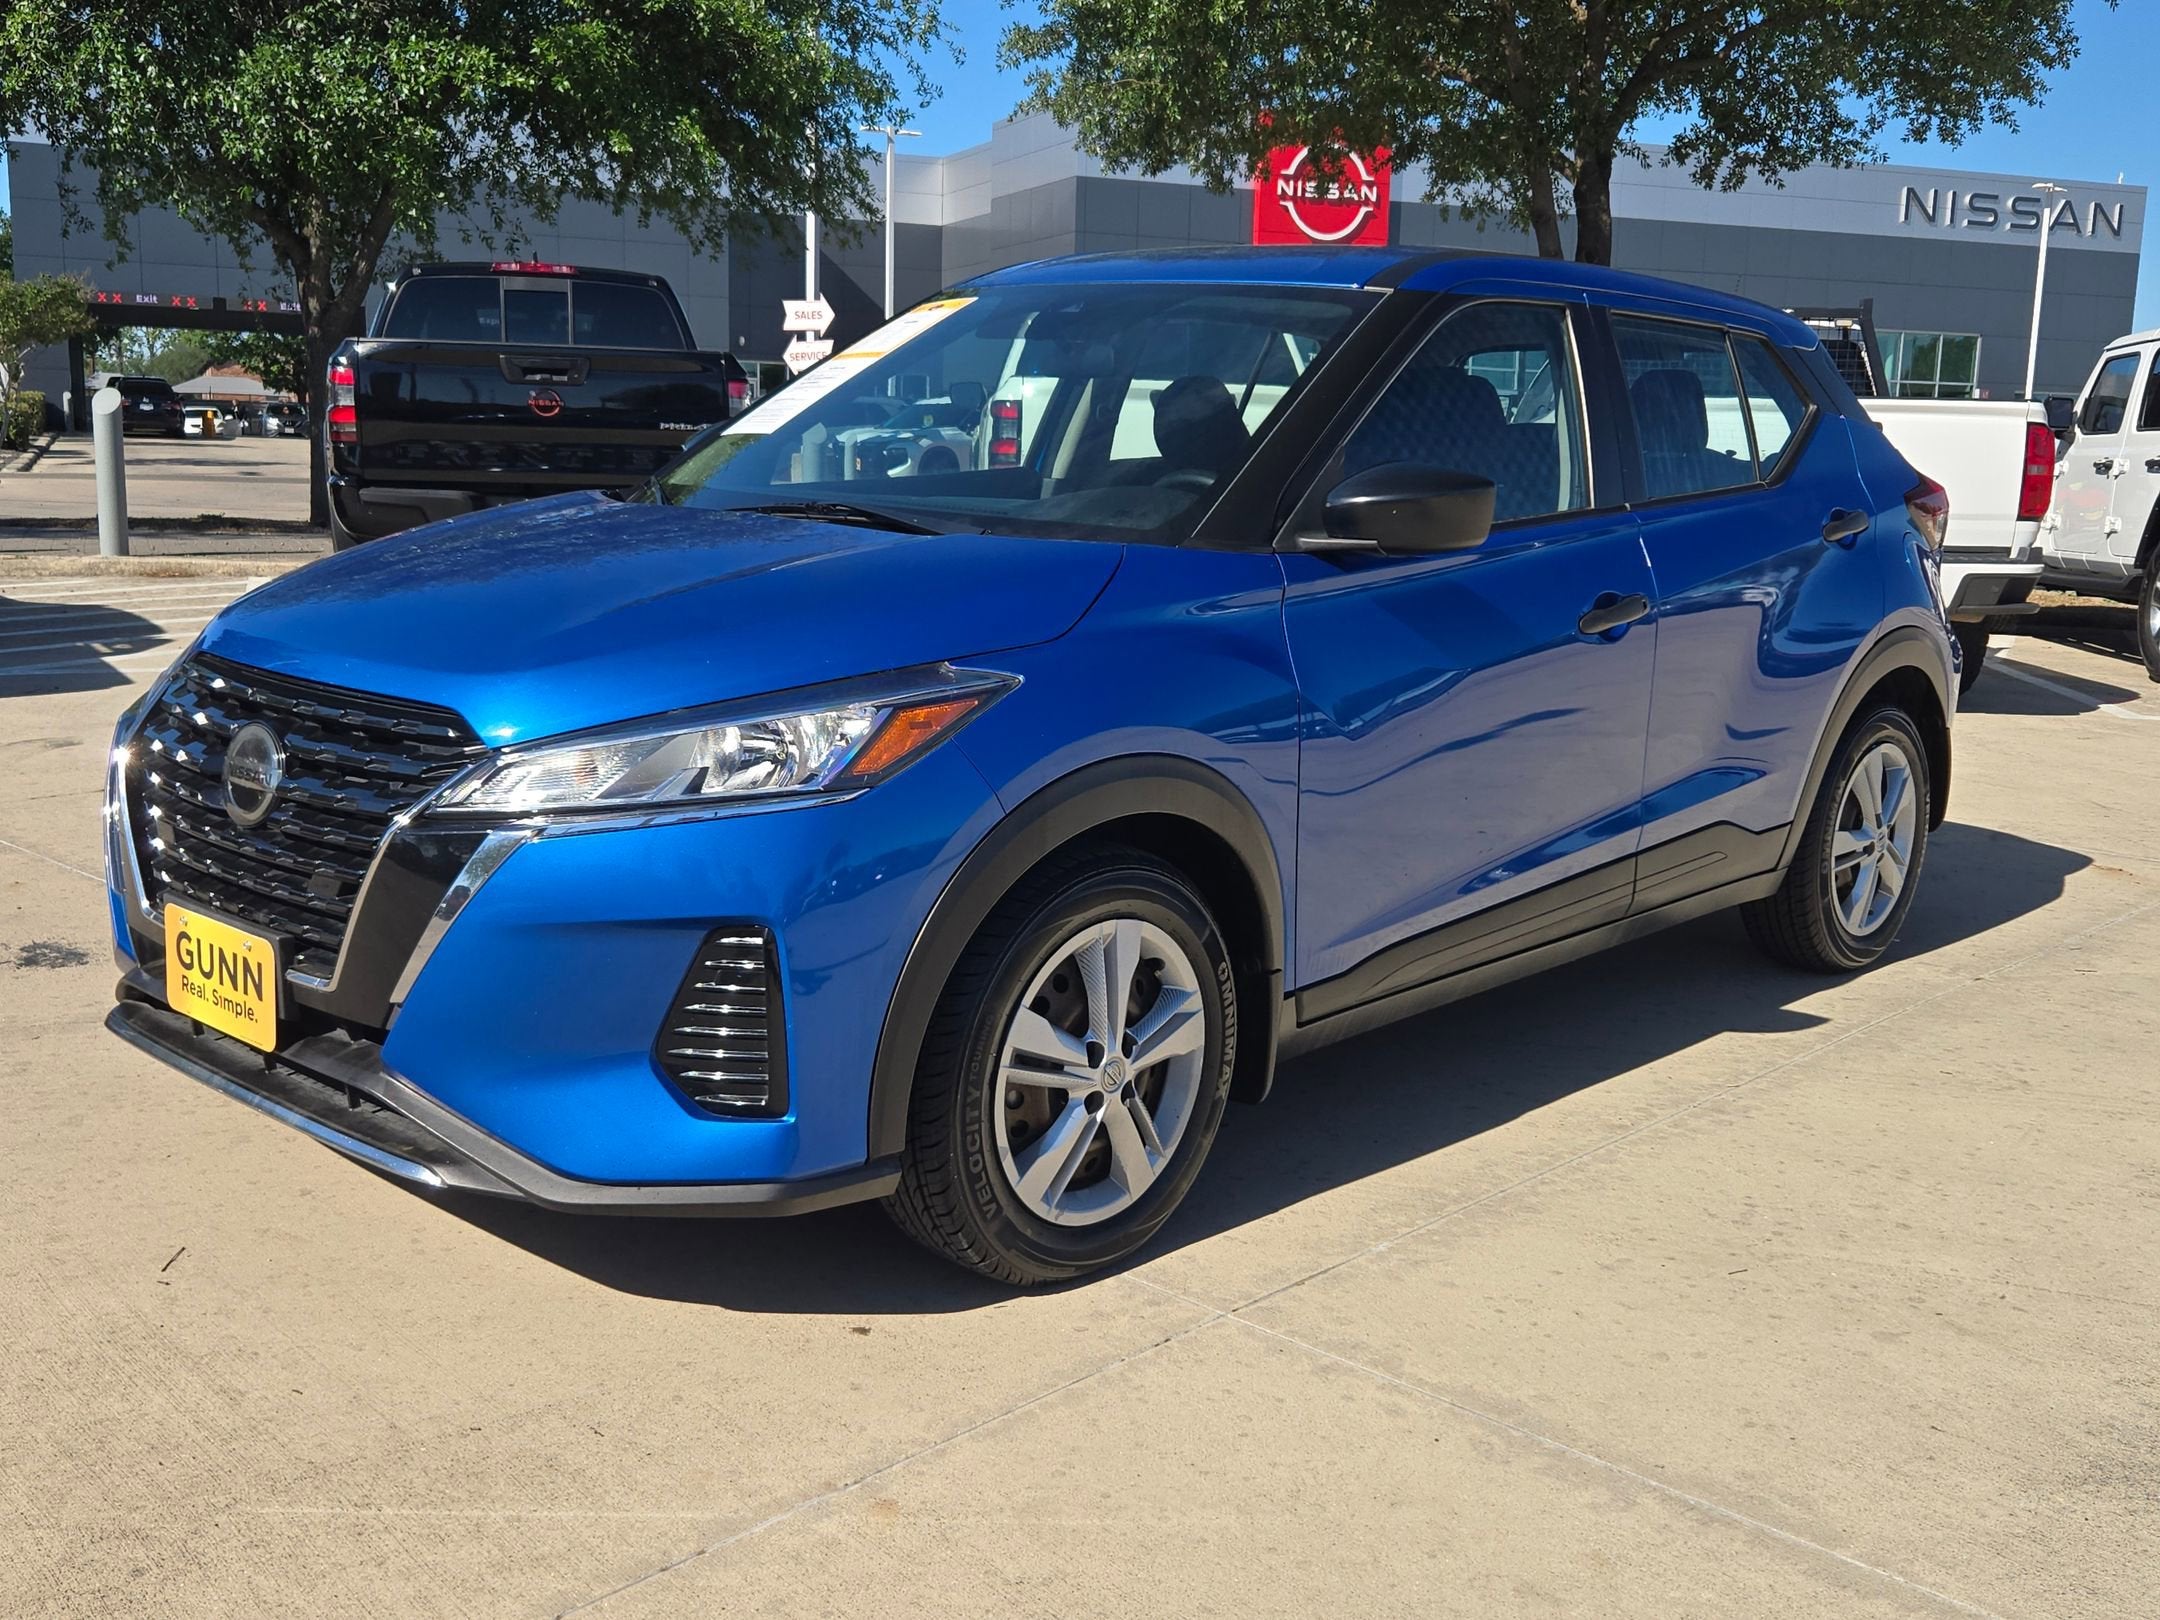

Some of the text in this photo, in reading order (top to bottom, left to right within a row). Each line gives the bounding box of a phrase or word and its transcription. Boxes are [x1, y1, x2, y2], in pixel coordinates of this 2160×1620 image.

[1276, 178, 1378, 203] NISSAN
[1898, 185, 2126, 239] NISSAN
[135, 294, 158, 304] Exit
[794, 310, 823, 321] SALES
[175, 930, 264, 1003] GUNN
[181, 973, 209, 1002] Real.
[965, 1086, 998, 1220] VELOCITY
